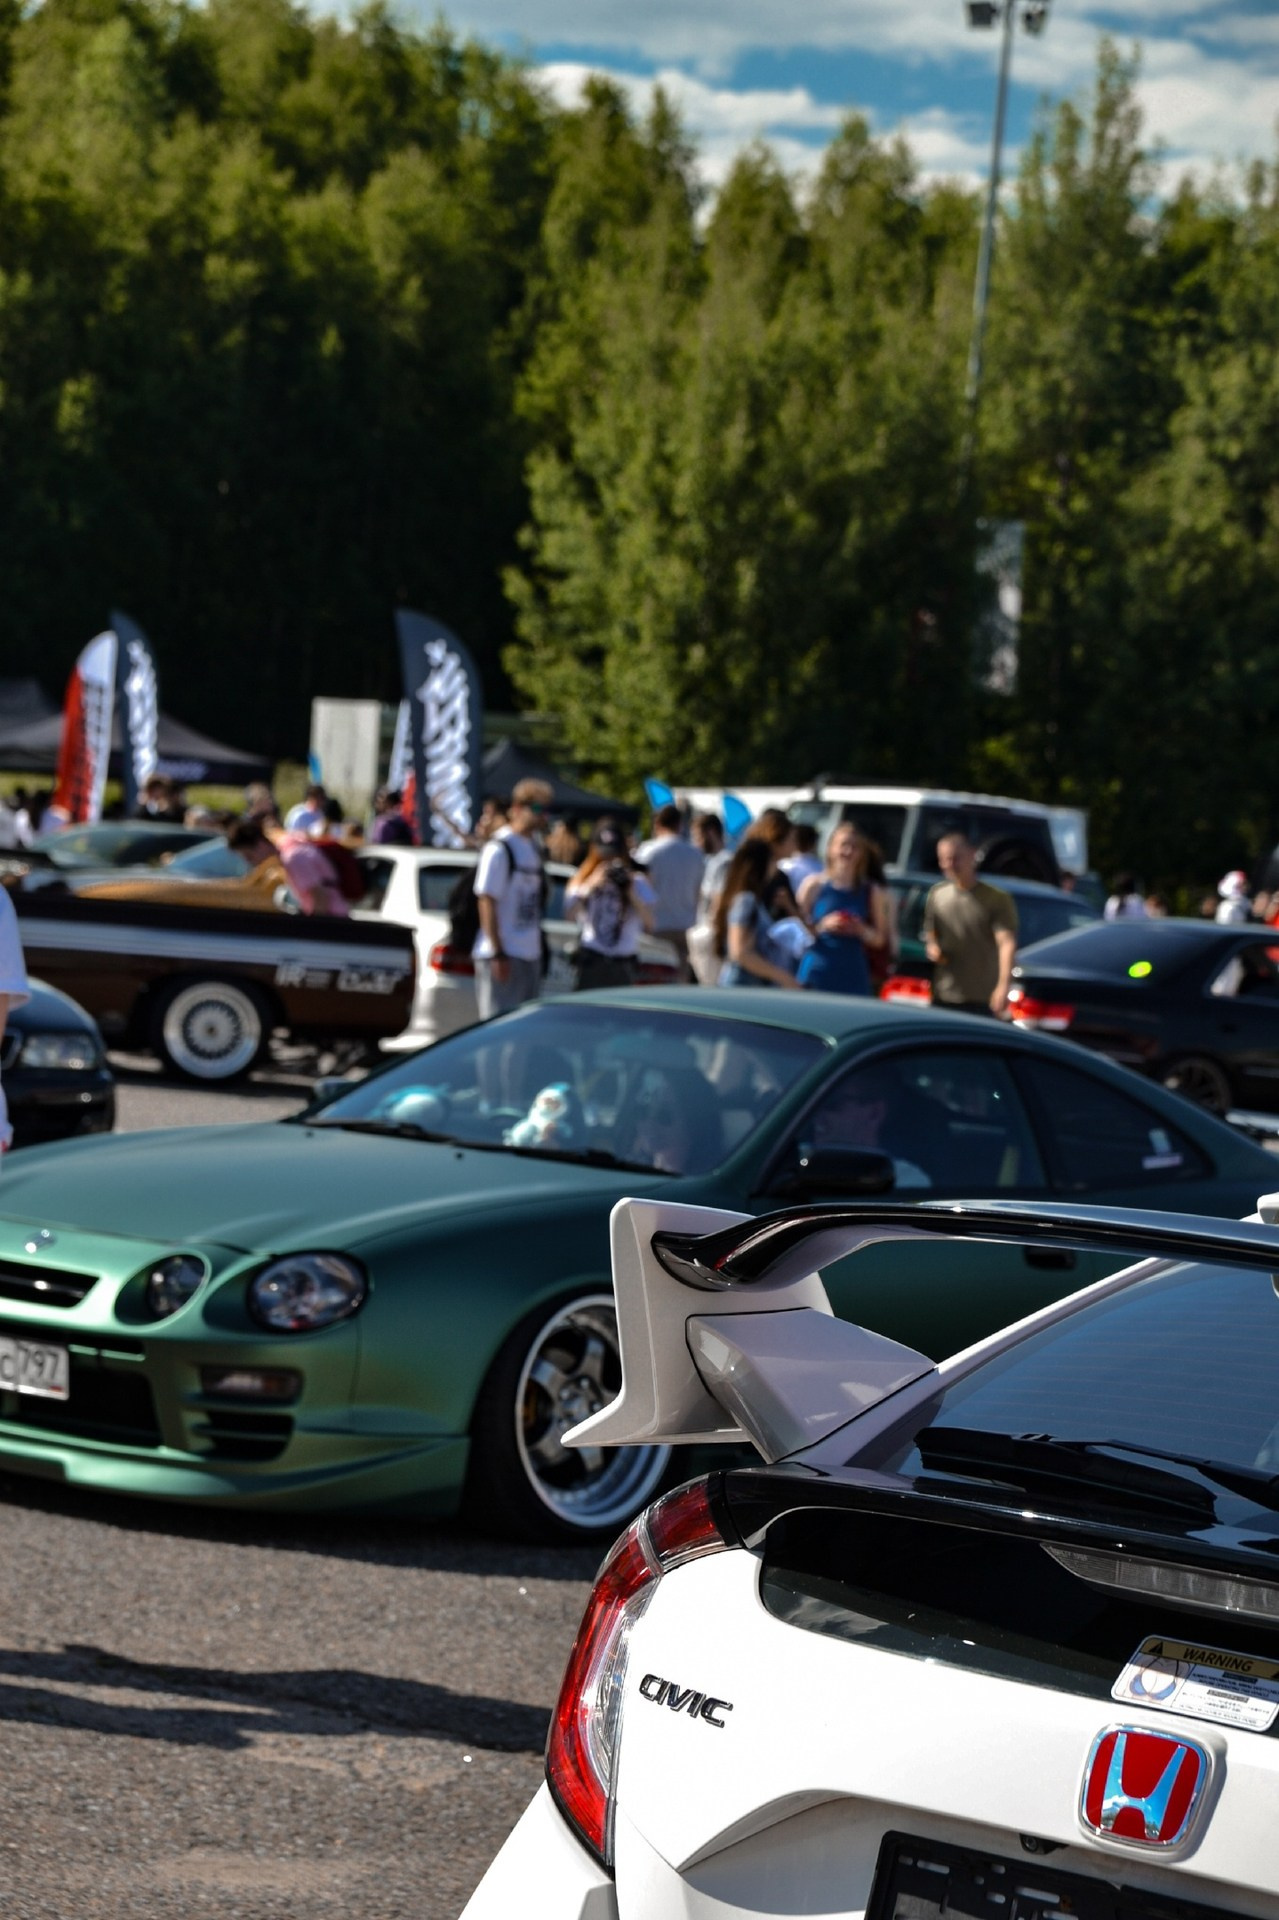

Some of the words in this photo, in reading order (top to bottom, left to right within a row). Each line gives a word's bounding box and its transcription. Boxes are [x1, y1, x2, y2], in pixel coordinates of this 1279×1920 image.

[18, 1345, 58, 1380] 797
[1183, 1647, 1254, 1672] WARNING
[639, 1673, 733, 1728] CIVIC
